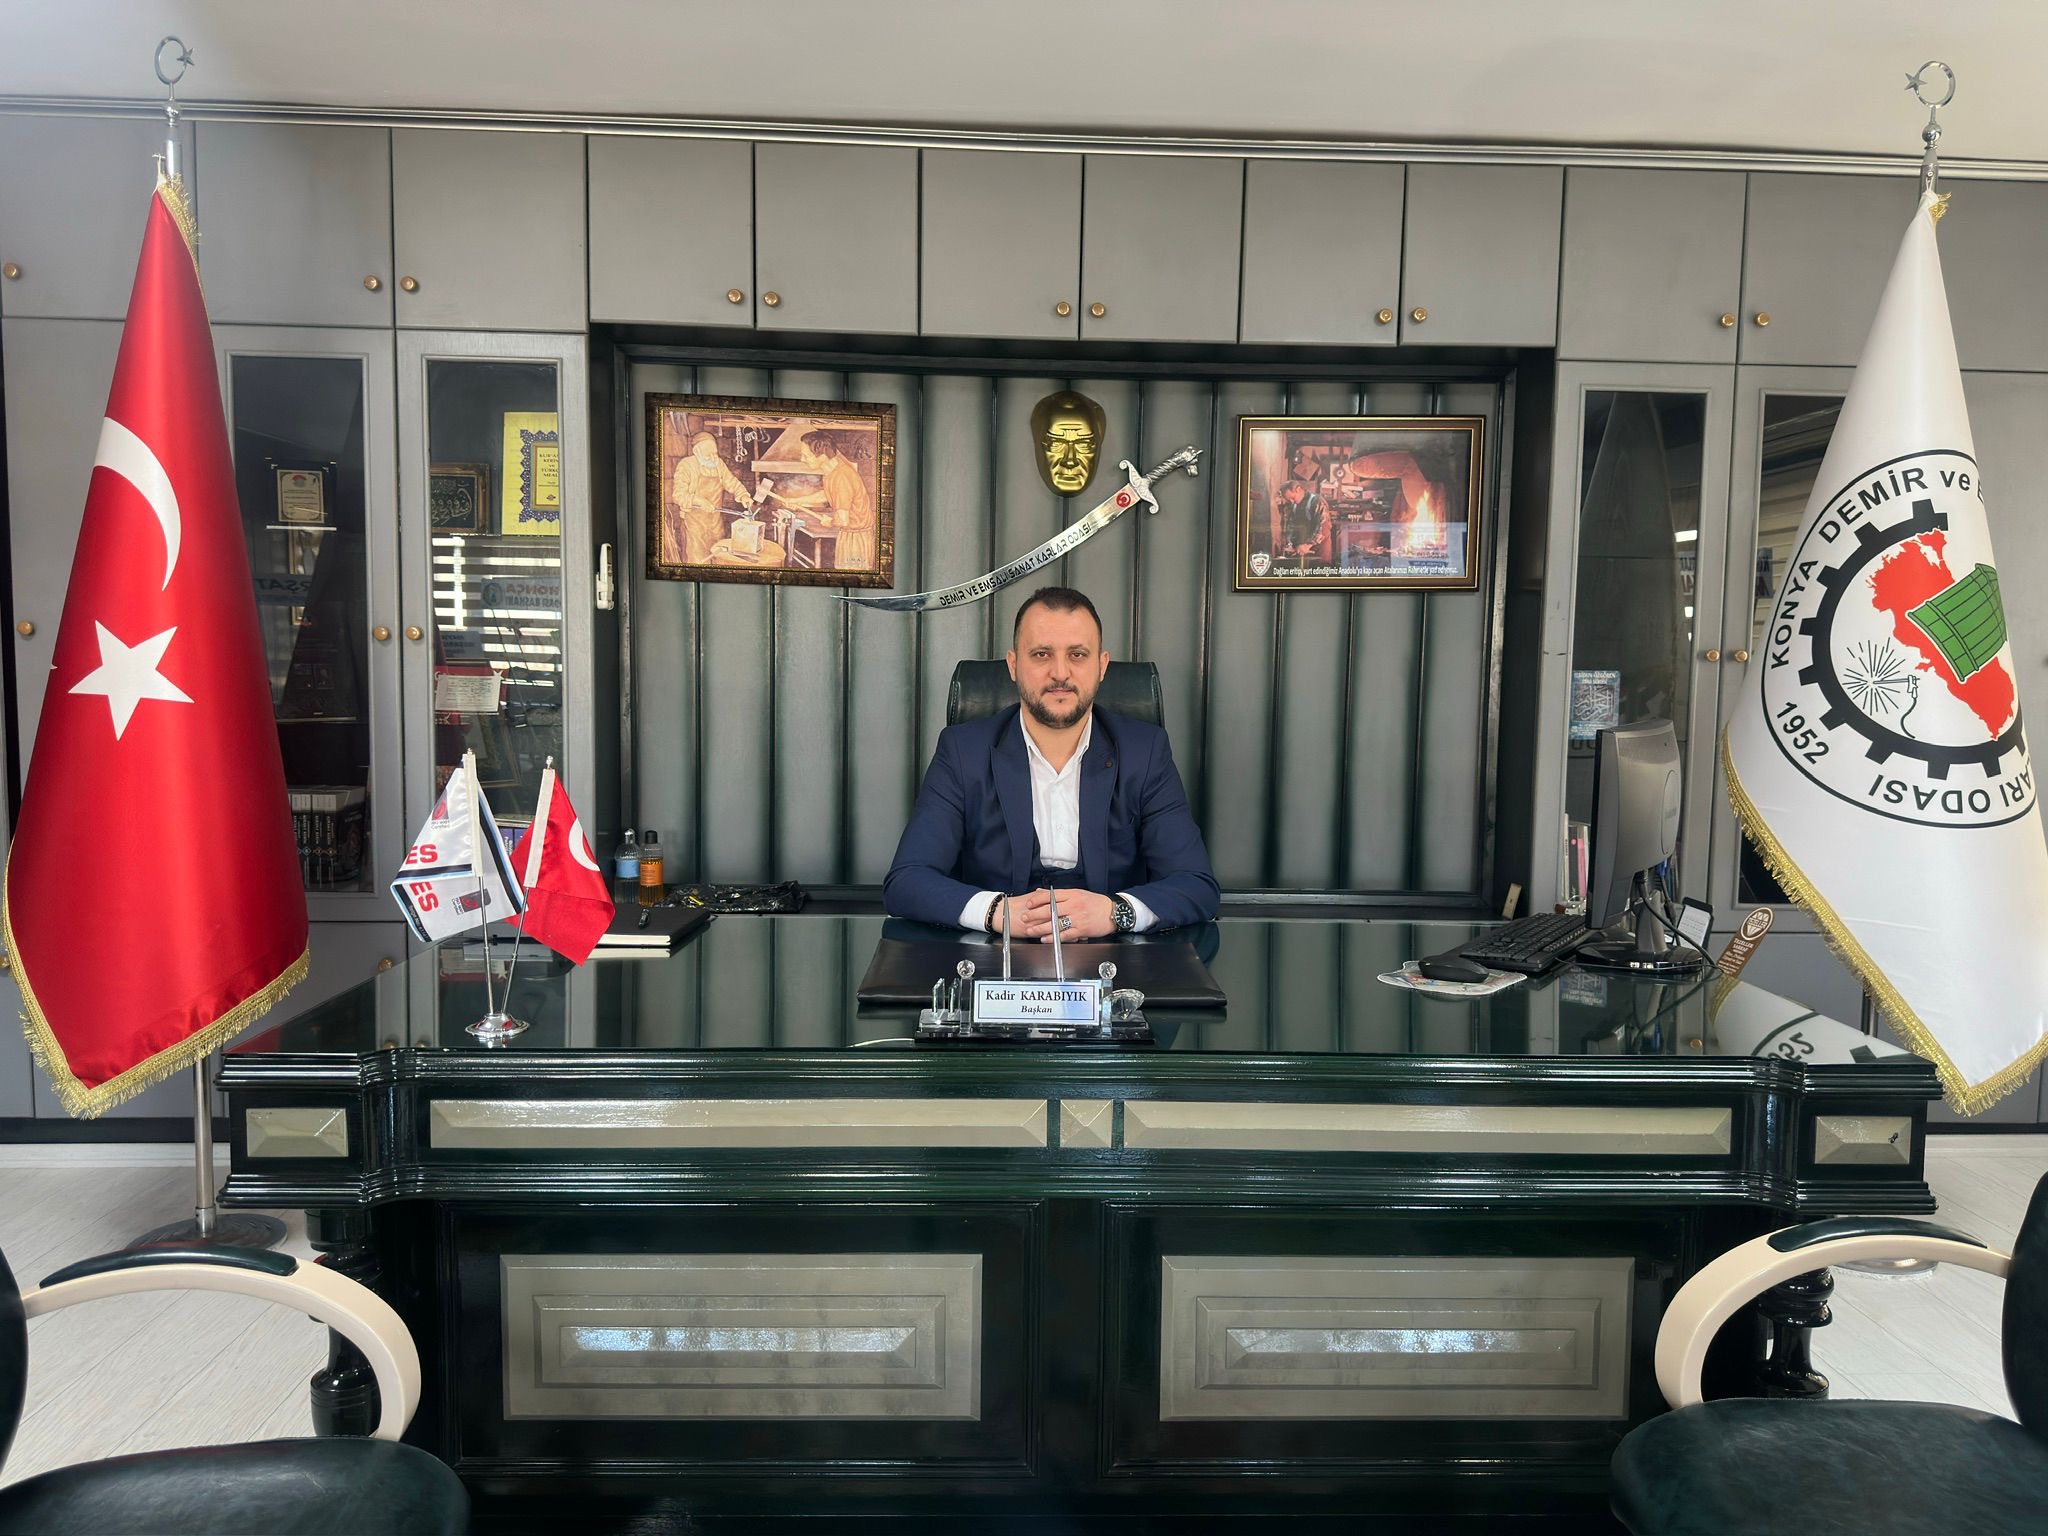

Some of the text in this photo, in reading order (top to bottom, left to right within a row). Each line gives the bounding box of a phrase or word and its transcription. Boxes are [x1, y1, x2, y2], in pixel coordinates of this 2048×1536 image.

[1007, 557, 1036, 579] SANAT
[1067, 521, 1092, 544] ODASI
[1771, 558, 1818, 669] KONYA
[1818, 467, 1927, 545] DEMİR
[1938, 469, 1971, 491] ve
[1775, 701, 1829, 765] 1952
[1868, 774, 1991, 814] ODASI
[985, 990, 1087, 1002] Kadir KARABIYIK
[1021, 1005, 1052, 1015] Başkan
